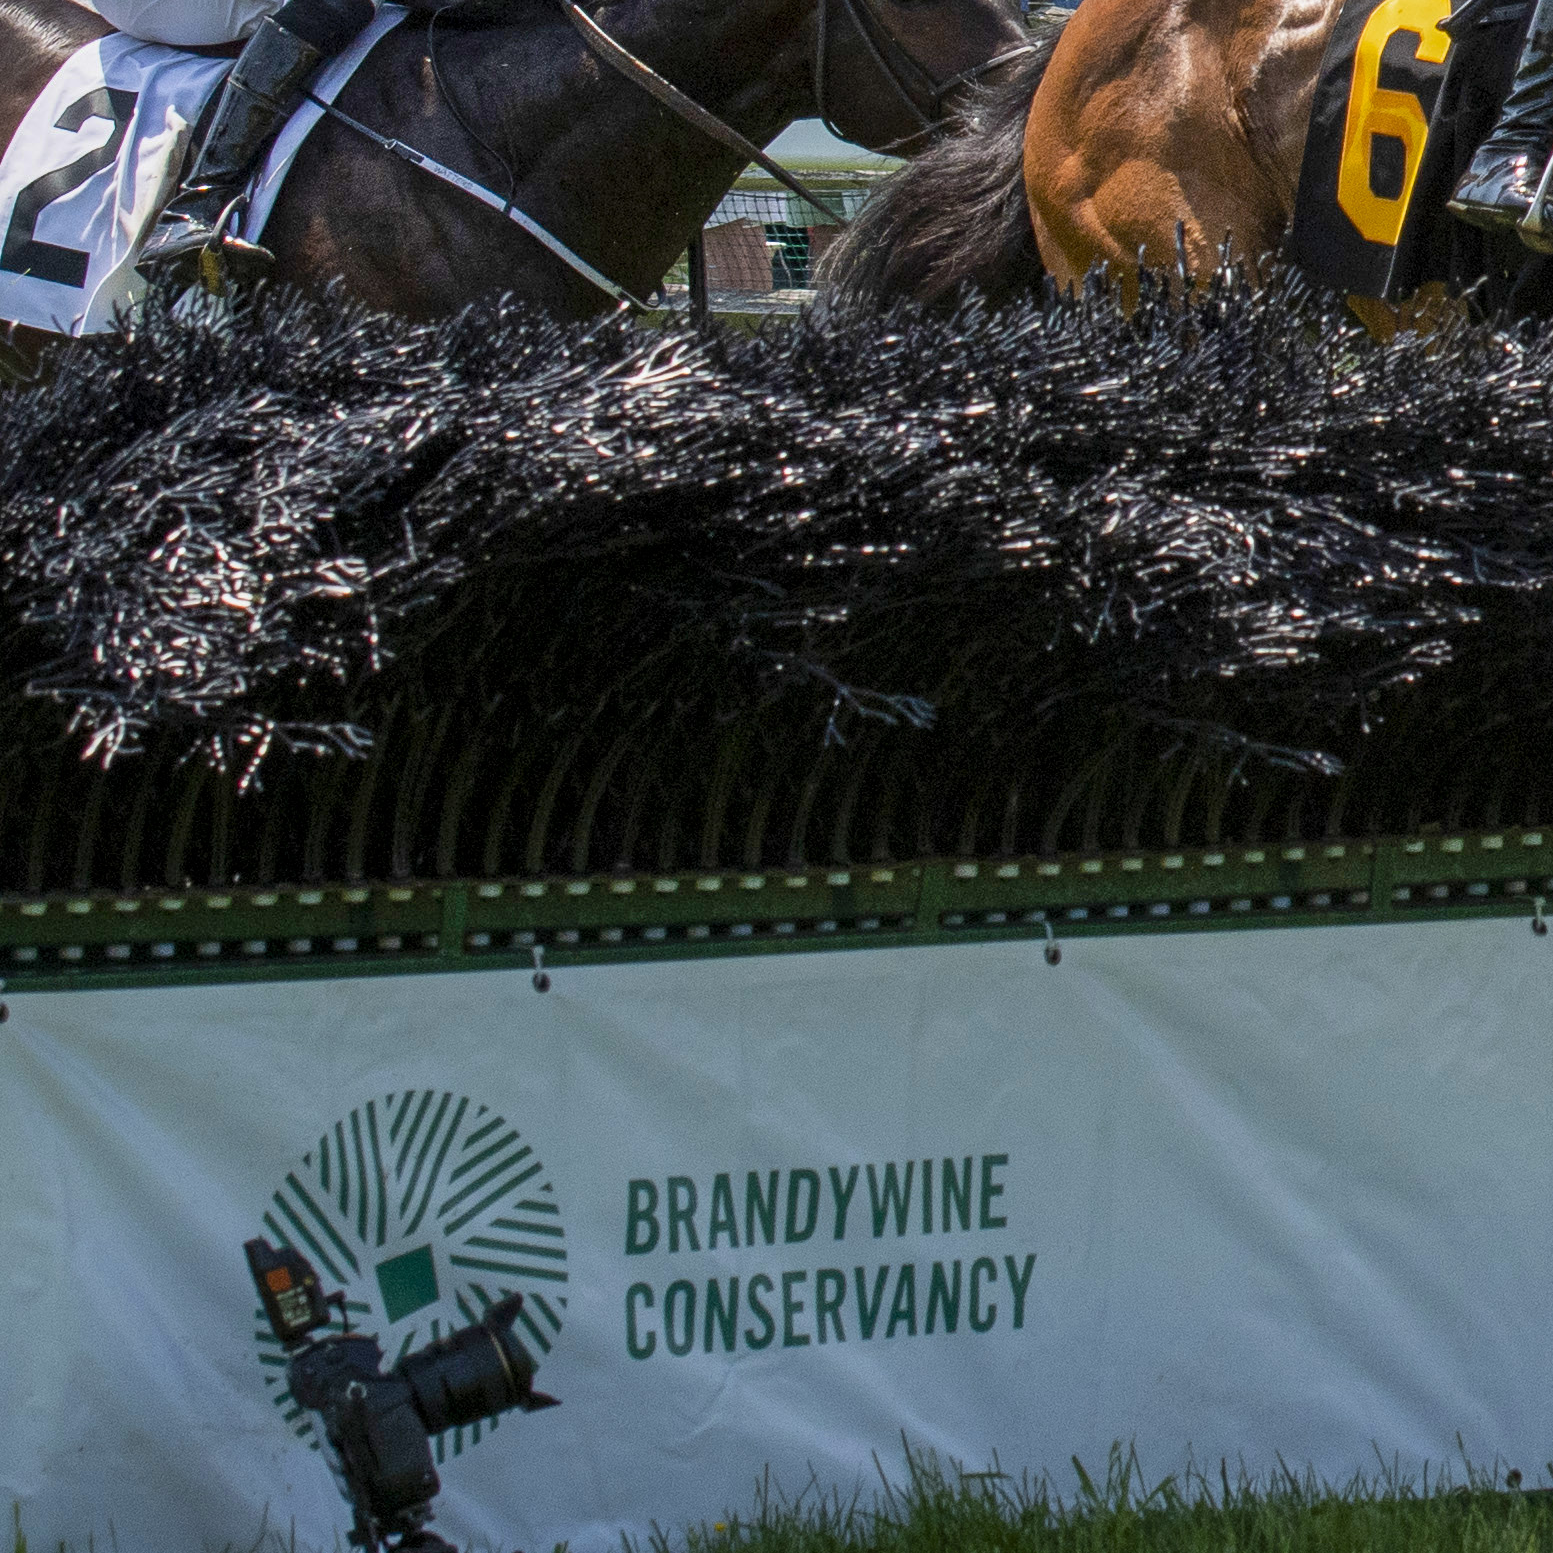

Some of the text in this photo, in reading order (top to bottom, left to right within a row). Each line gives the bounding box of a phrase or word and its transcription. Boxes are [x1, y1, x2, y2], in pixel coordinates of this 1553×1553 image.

[0, 86, 139, 288] 2
[625, 1153, 1009, 1255] BRANDYWINE
[625, 1253, 1038, 1360] CONSERVANCY
